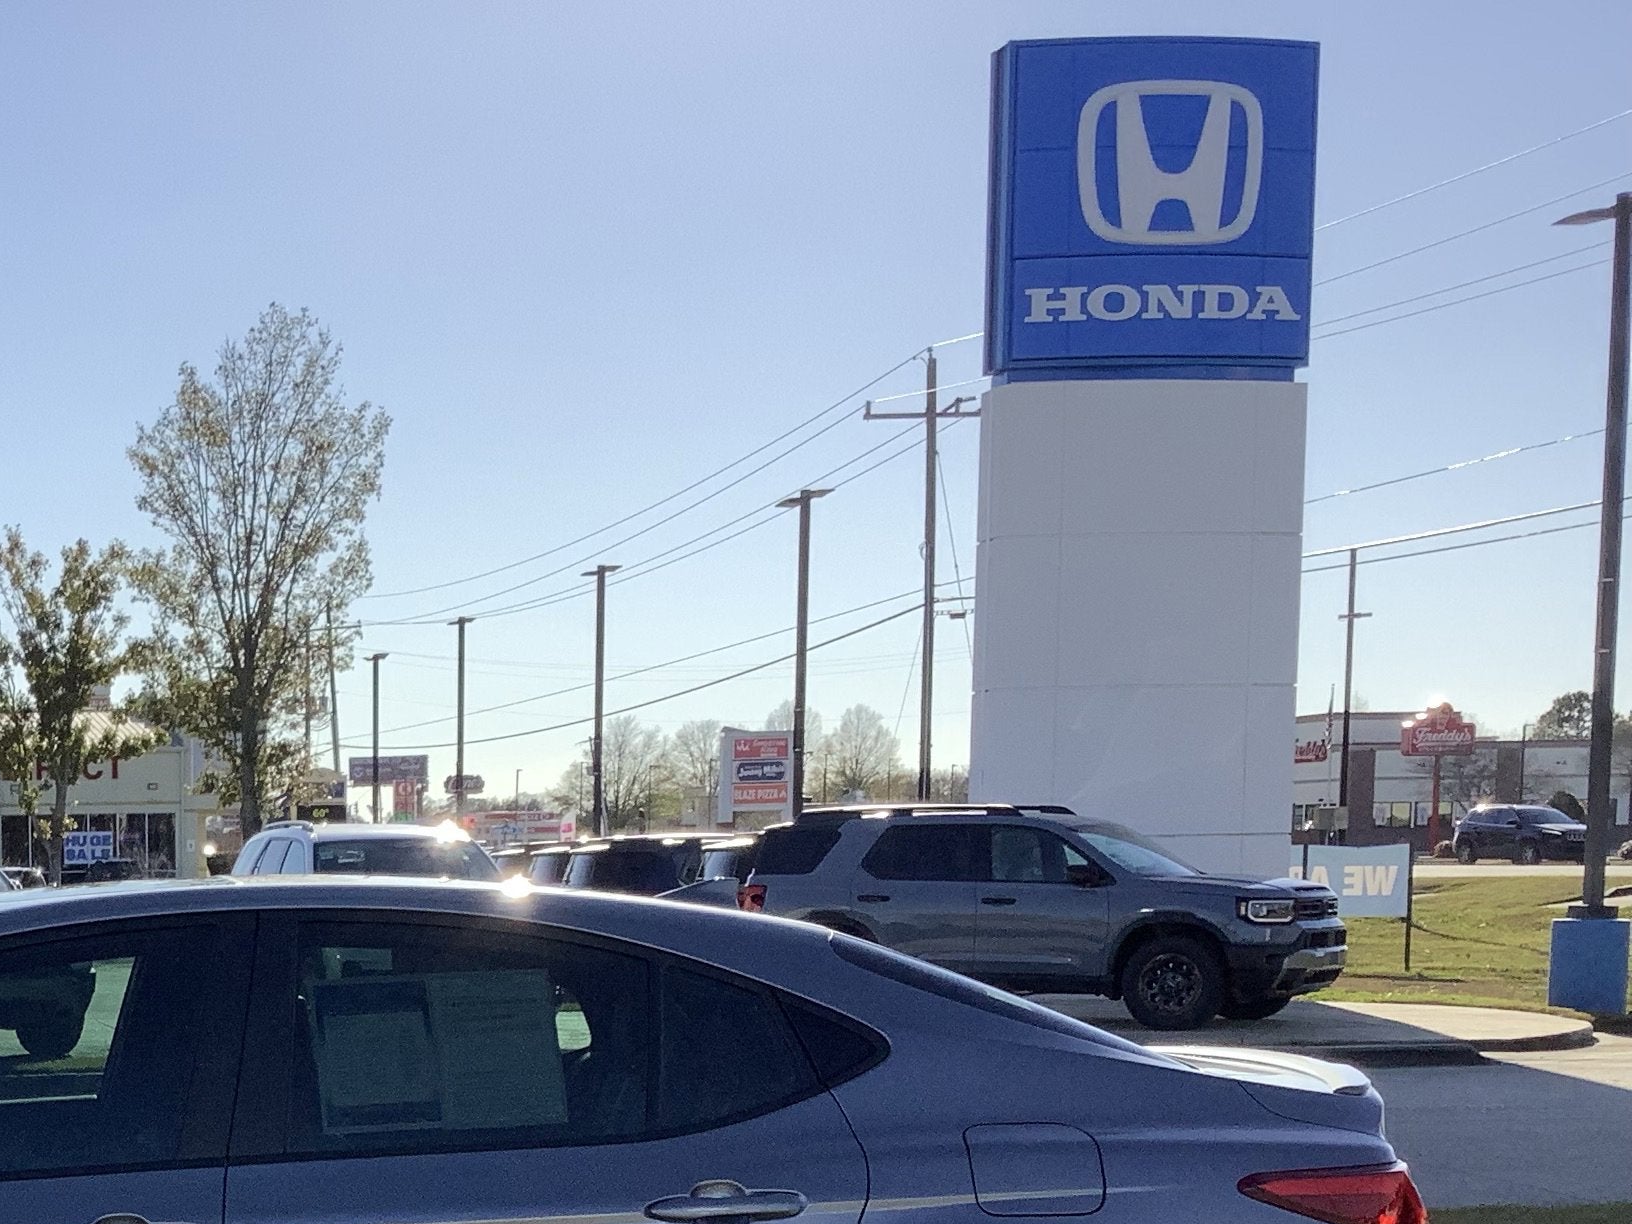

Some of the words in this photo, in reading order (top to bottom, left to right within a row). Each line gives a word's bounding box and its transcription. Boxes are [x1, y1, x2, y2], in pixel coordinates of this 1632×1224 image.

[1024, 284, 1301, 323] HONDA
[1413, 727, 1472, 747] Freddy's
[65, 834, 112, 847] HUGE
[66, 848, 111, 861] SALE
